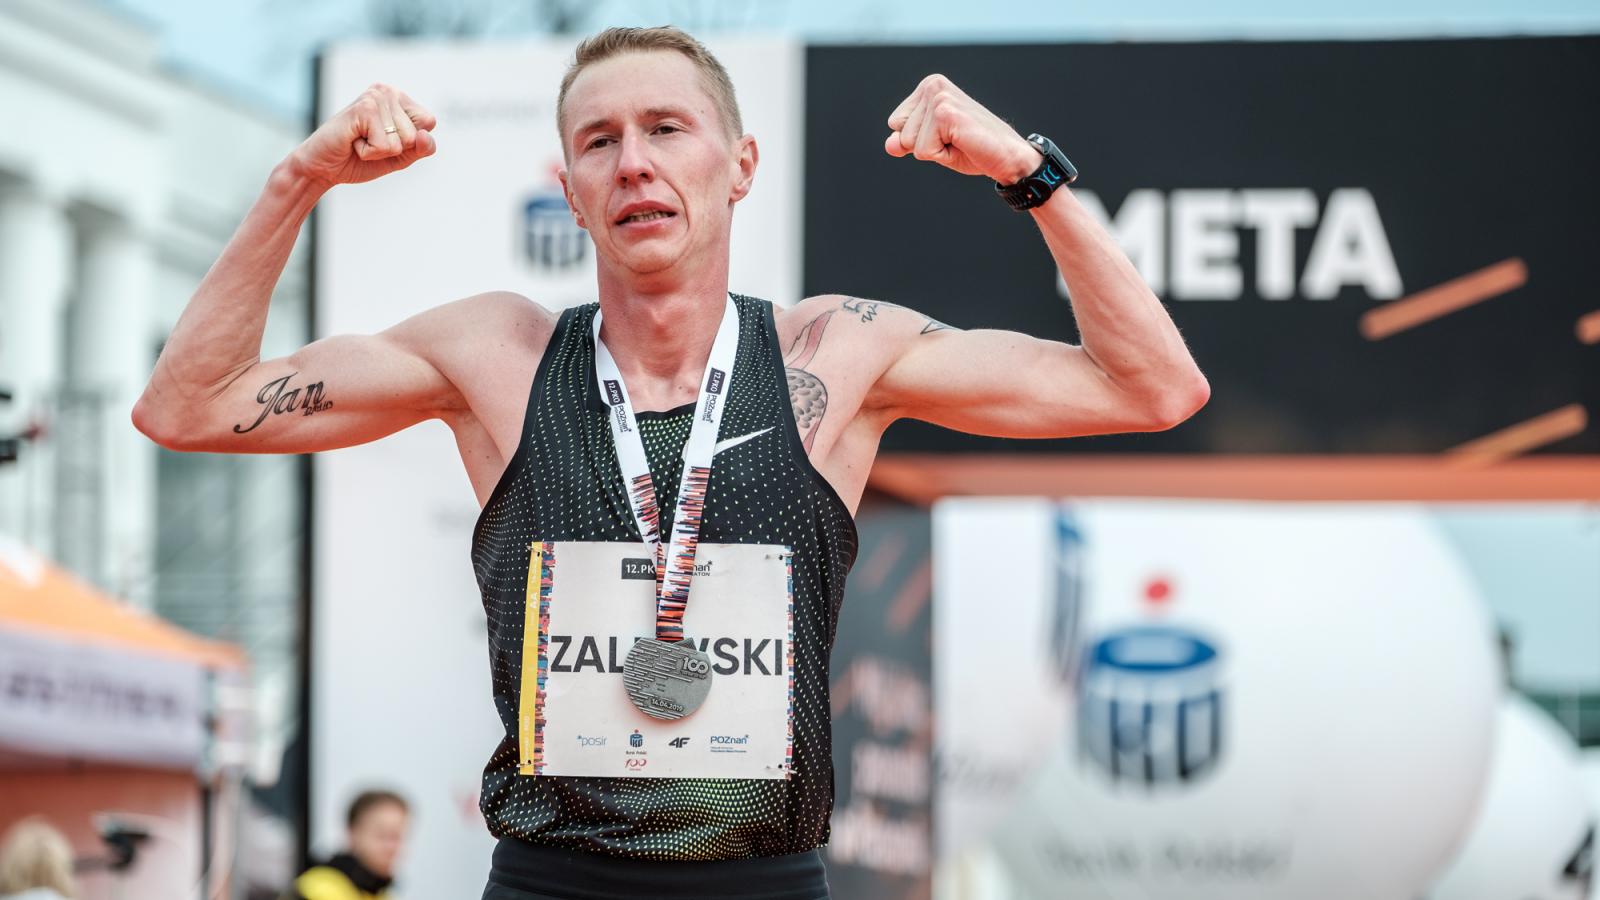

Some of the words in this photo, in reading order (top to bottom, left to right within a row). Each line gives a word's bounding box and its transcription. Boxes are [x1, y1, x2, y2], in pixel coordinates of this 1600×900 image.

[607, 382, 621, 403] 12.PKO
[233, 372, 326, 434] Jan
[625, 564, 656, 574] 12.PK
[550, 635, 783, 676] ZALSKI
[682, 657, 708, 674] 100
[668, 737, 690, 748] 4F
